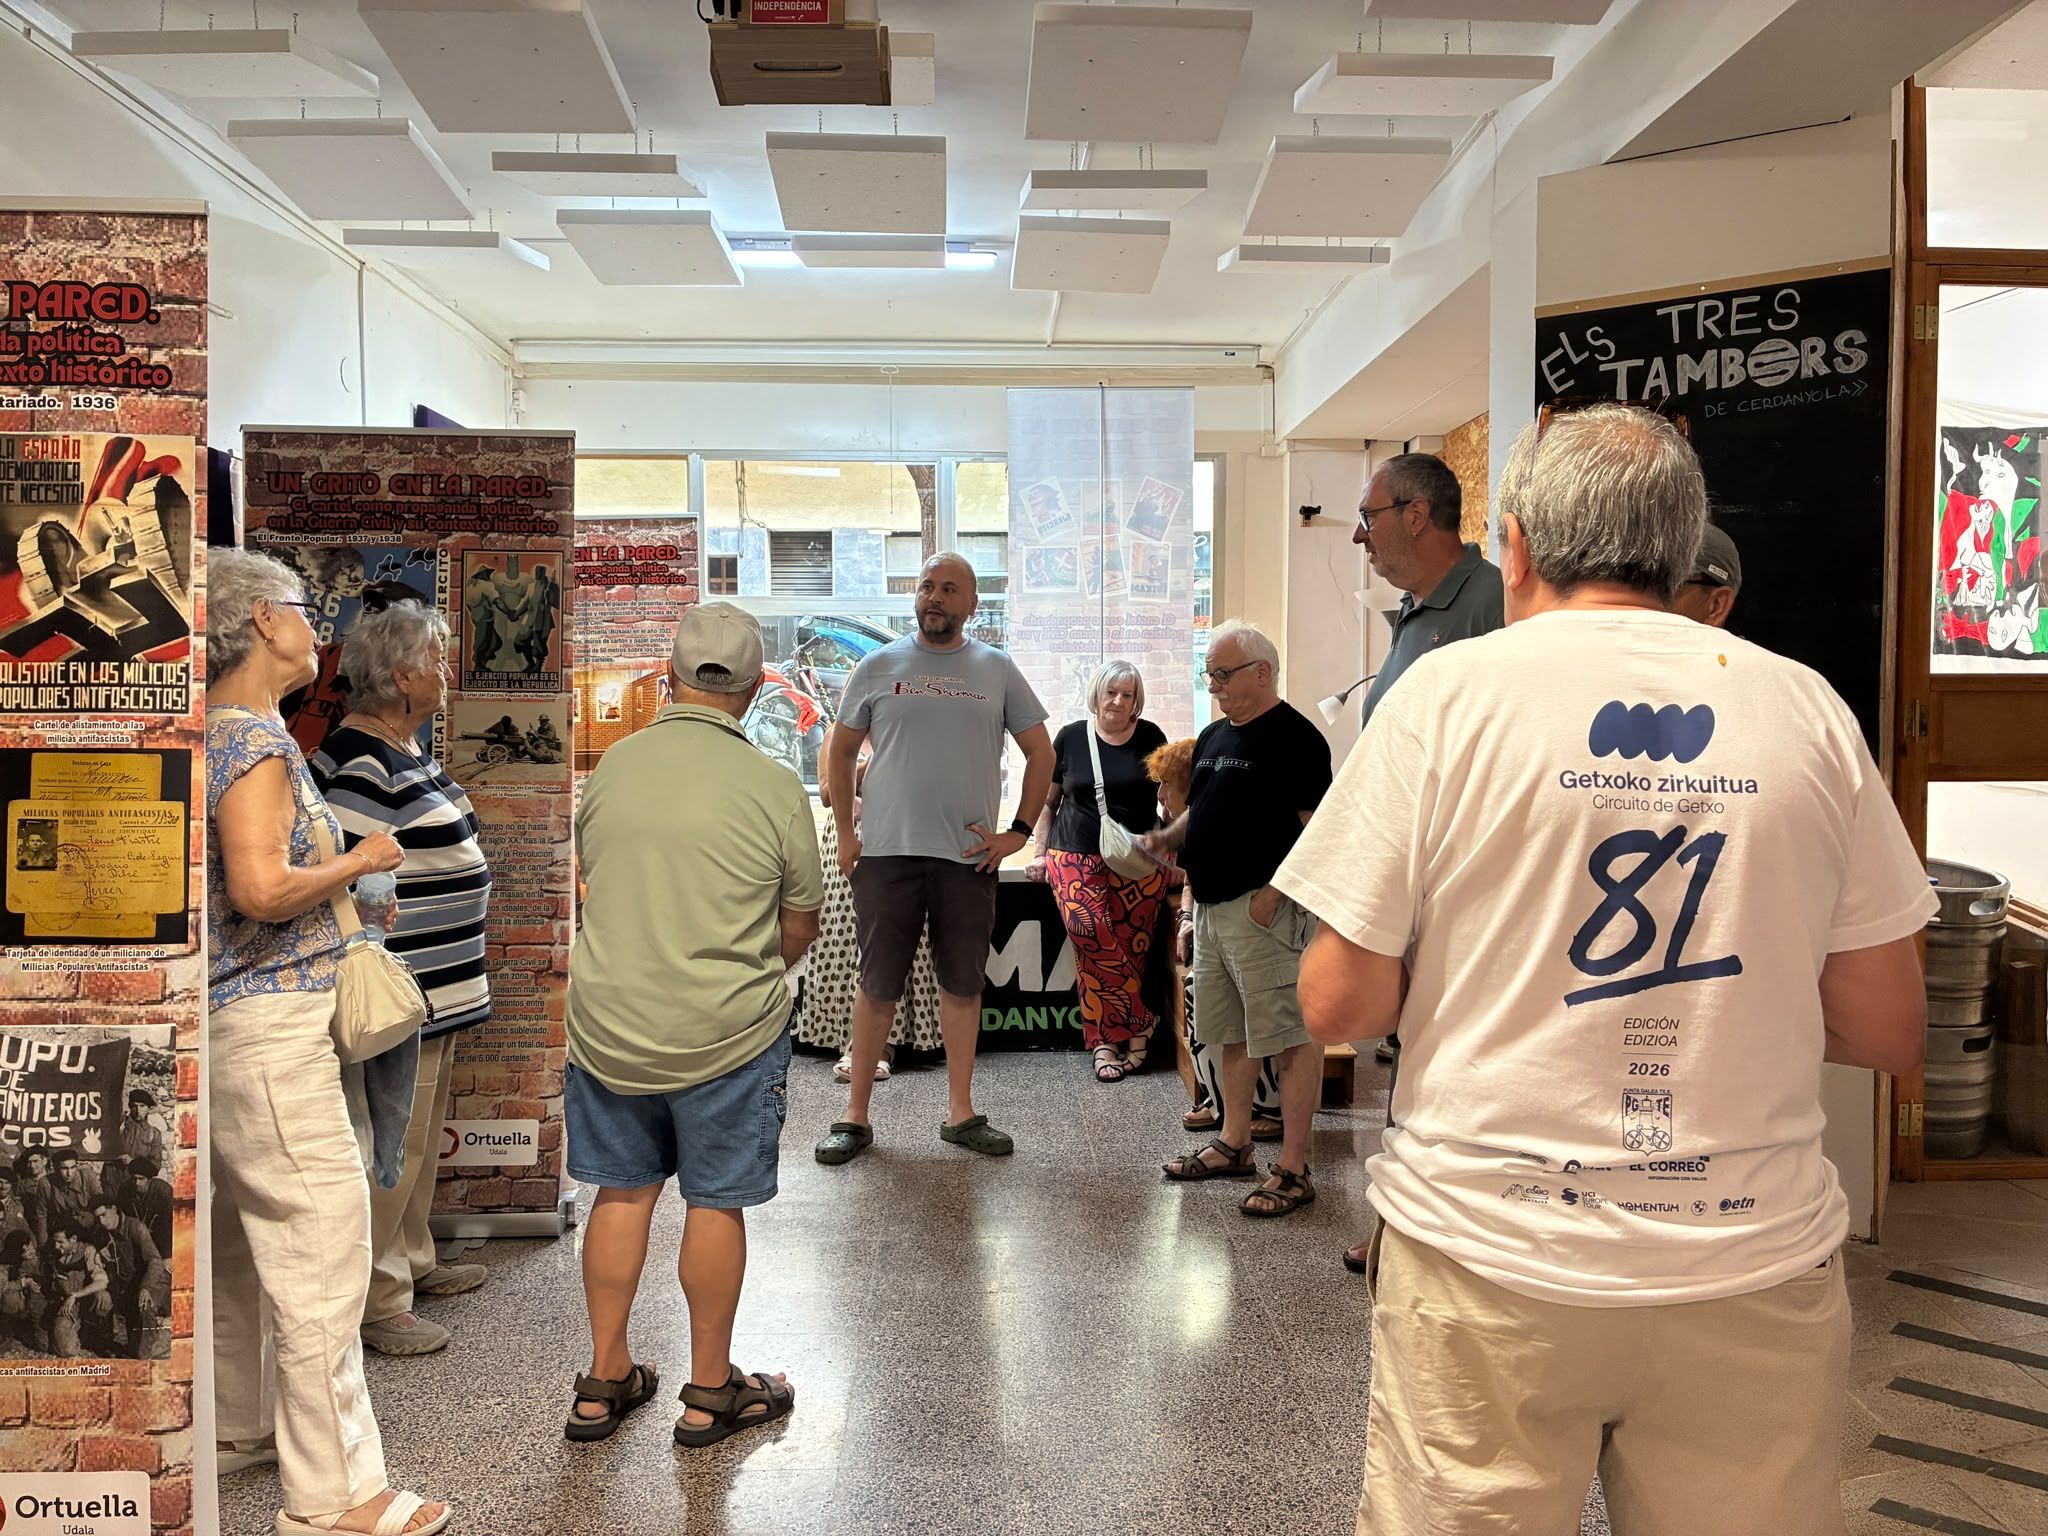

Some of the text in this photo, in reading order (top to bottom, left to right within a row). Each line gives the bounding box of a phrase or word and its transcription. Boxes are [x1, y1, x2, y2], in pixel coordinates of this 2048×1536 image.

[11, 284, 158, 322] PARED.
[1655, 288, 1801, 344] TRES
[27, 328, 121, 358] política
[1540, 326, 1616, 394] ELS
[1600, 329, 1869, 401] TAMBORS
[0, 357, 171, 386] xto histórico
[73, 397, 116, 409] 1936
[1704, 399, 1728, 419] DE
[0, 435, 81, 459] LA ESPAÑA
[268, 473, 552, 498] UN GRITO EN LA PARED.
[21, 482, 84, 504] NECESITA!
[292, 498, 532, 518] El cartel como propaganda política
[269, 515, 558, 534] en la Guerra Civil y su contexto histórico
[257, 533, 367, 544] El Frente Popular. 1937
[599, 546, 681, 561] LA PARED.
[574, 563, 630, 575] propaganda
[437, 549, 449, 617] JERCITO
[583, 573, 687, 586] su contexto histórico
[0, 661, 187, 686] ALISTATE EN LAS MILICIAS
[475, 672, 559, 681] EJERCITO POPULAR ES EL
[465, 680, 559, 690] EJERCITO DE LA REPUBLICA
[889, 681, 990, 702] Ben Sherman
[74, 687, 186, 710] ANTIFASCISTAS!
[35, 721, 59, 730] Cartel
[61, 721, 70, 730] de
[72, 721, 121, 730] alistamiento
[47, 734, 130, 743] milicias antifascistas
[1559, 770, 1759, 794] Getxoko zirkuitua
[1592, 794, 1725, 814] Circuito de Getxo
[23, 809, 173, 818] MILICIAS POPULARES ANTIFASCISTAS
[528, 823, 548, 831] hasta
[496, 865, 517, 873] surge
[499, 891, 525, 899] masas
[1567, 824, 1729, 977] 81
[513, 917, 545, 927] injusticia
[7, 948, 165, 959] Tarjeta de identidad de un miliciano de
[21, 962, 149, 973] Milicias Populares Antifascistas
[492, 957, 536, 967] Guerra Civil
[493, 986, 522, 994] crearon
[493, 999, 545, 1007] distintos entre
[1623, 1016, 1680, 1030] EDICIÓN
[471, 1026, 549, 1036] del bando sublevado,
[473, 1040, 506, 1048] alcanzar
[517, 1040, 534, 1048] total
[1623, 1034, 1678, 1047] EDIZIOA
[1628, 1062, 1671, 1077] 2026
[0, 1069, 29, 1091] DE
[1625, 1095, 1670, 1118] PG TE
[464, 1131, 532, 1147] Ortuella
[489, 1148, 508, 1156] Udala
[1648, 1160, 1706, 1173] CORREO
[15, 1367, 66, 1376] antifascistas
[80, 1366, 110, 1376] Madrid
[15, 1494, 139, 1519] Ortuella
[63, 1525, 94, 1535] Udala
